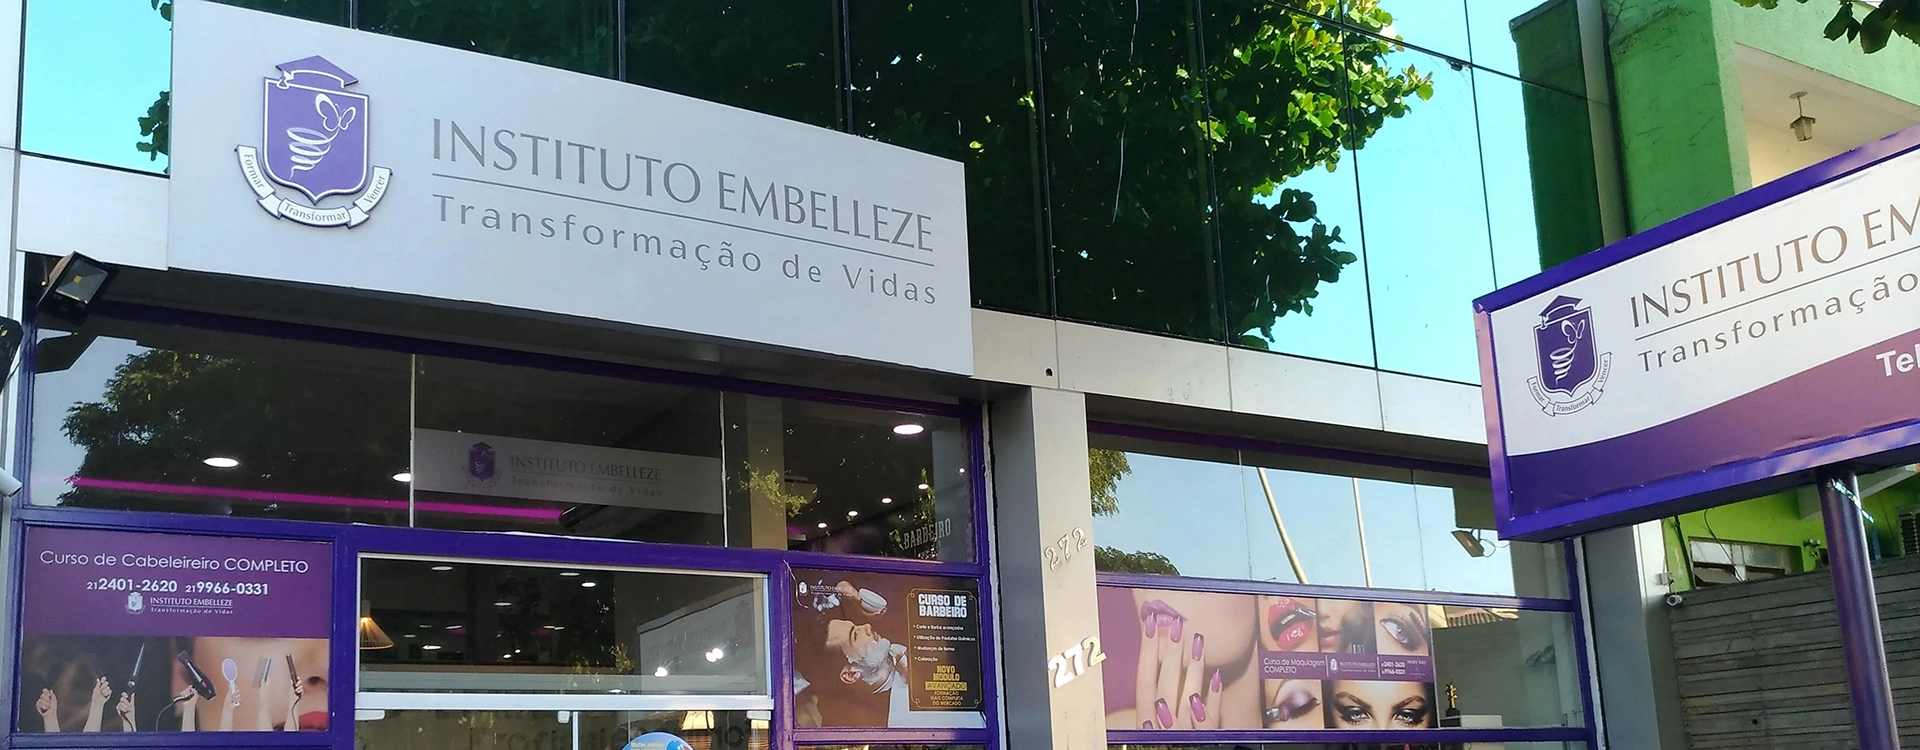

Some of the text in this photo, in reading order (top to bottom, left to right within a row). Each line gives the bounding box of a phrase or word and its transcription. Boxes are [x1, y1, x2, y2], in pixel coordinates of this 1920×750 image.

[243, 153, 265, 189] Formar
[363, 175, 386, 204] Vencer
[432, 117, 934, 252] INSTITUTO EMBELLEZE
[283, 202, 347, 223] Transformar
[432, 193, 937, 305] Transformação de Vidas
[1630, 225, 1848, 329] INSTITUTO
[1638, 272, 1920, 373] Transformação
[1597, 359, 1609, 384] Vencer
[1555, 395, 1592, 412] Transformar
[510, 455, 662, 480] INSTITUTO EMBELLEZE
[903, 517, 952, 551] BARBEIRO
[40, 550, 309, 573] Curso de Cabeleireiro COMPLETO
[1044, 527, 1088, 572] 272
[150, 597, 234, 607] INSTITUTO EMBELLEZE
[917, 593, 967, 607] CURSO DE
[918, 604, 968, 618] BARBEIRO
[936, 665, 955, 674] NOVO
[1048, 635, 1107, 688] 272
[1281, 658, 1290, 666] de
